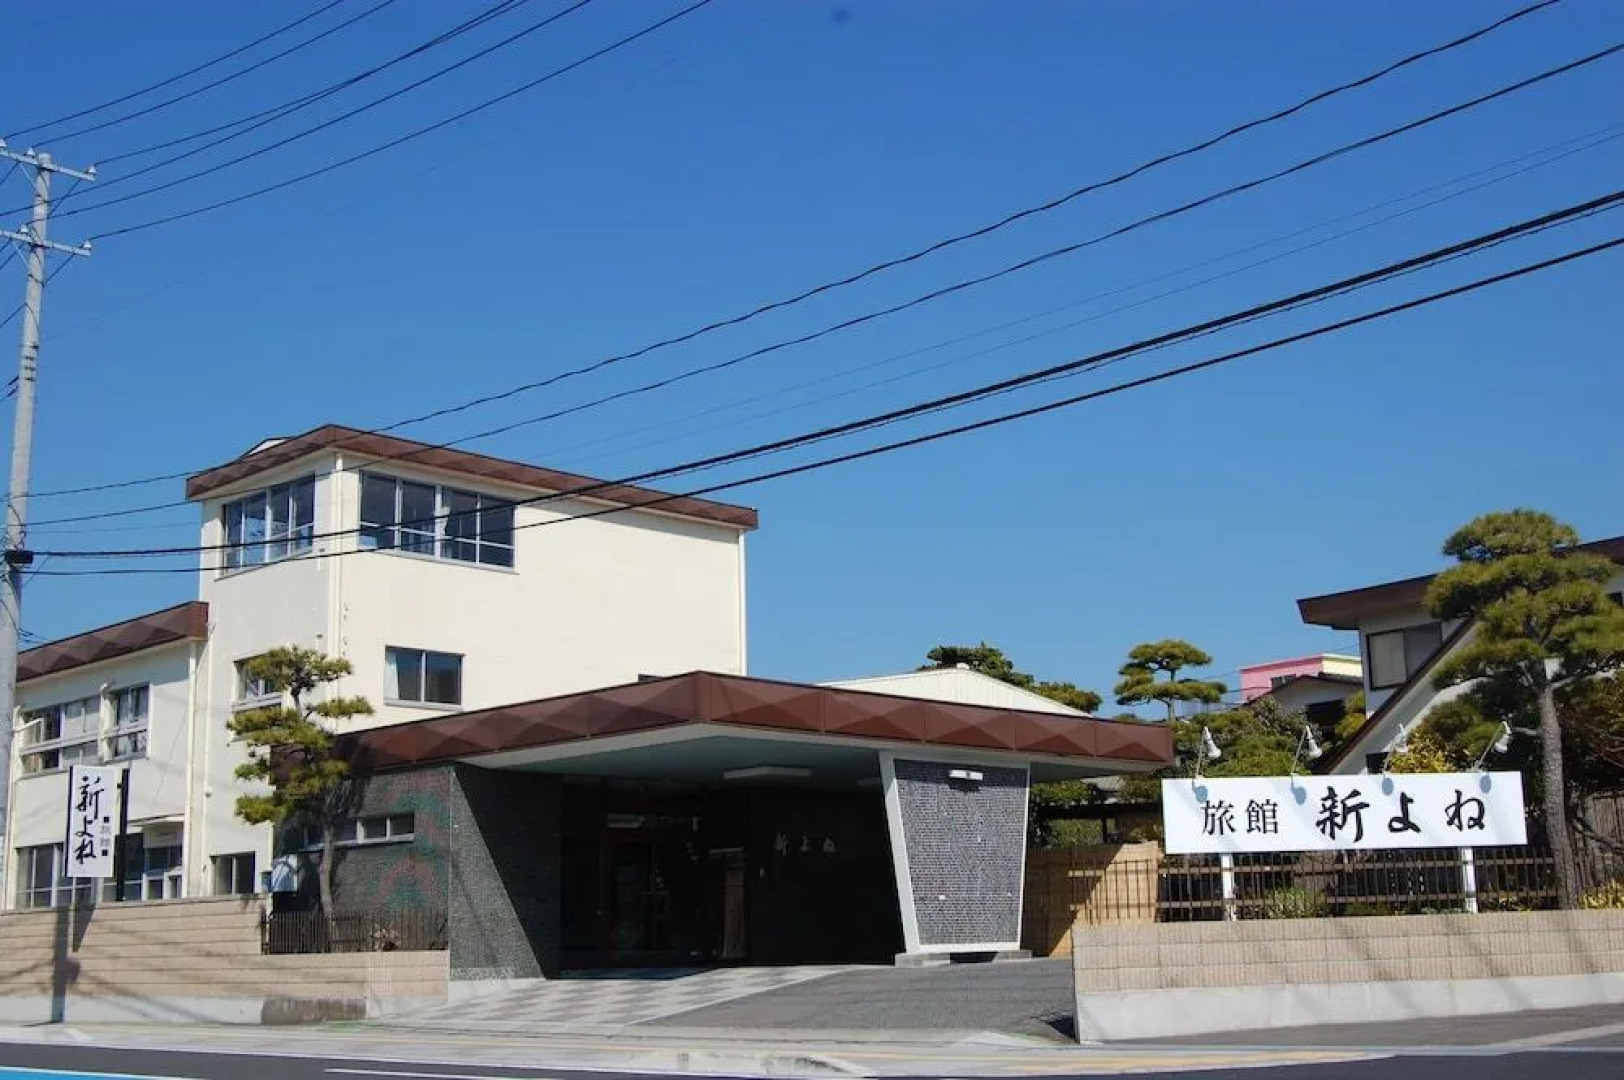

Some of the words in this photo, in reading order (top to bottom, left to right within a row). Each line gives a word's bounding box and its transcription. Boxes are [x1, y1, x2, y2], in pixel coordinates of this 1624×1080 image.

[74, 776, 104, 864] 新よね
[1200, 798, 1278, 836] 旅館
[1315, 786, 1487, 843] 新よね
